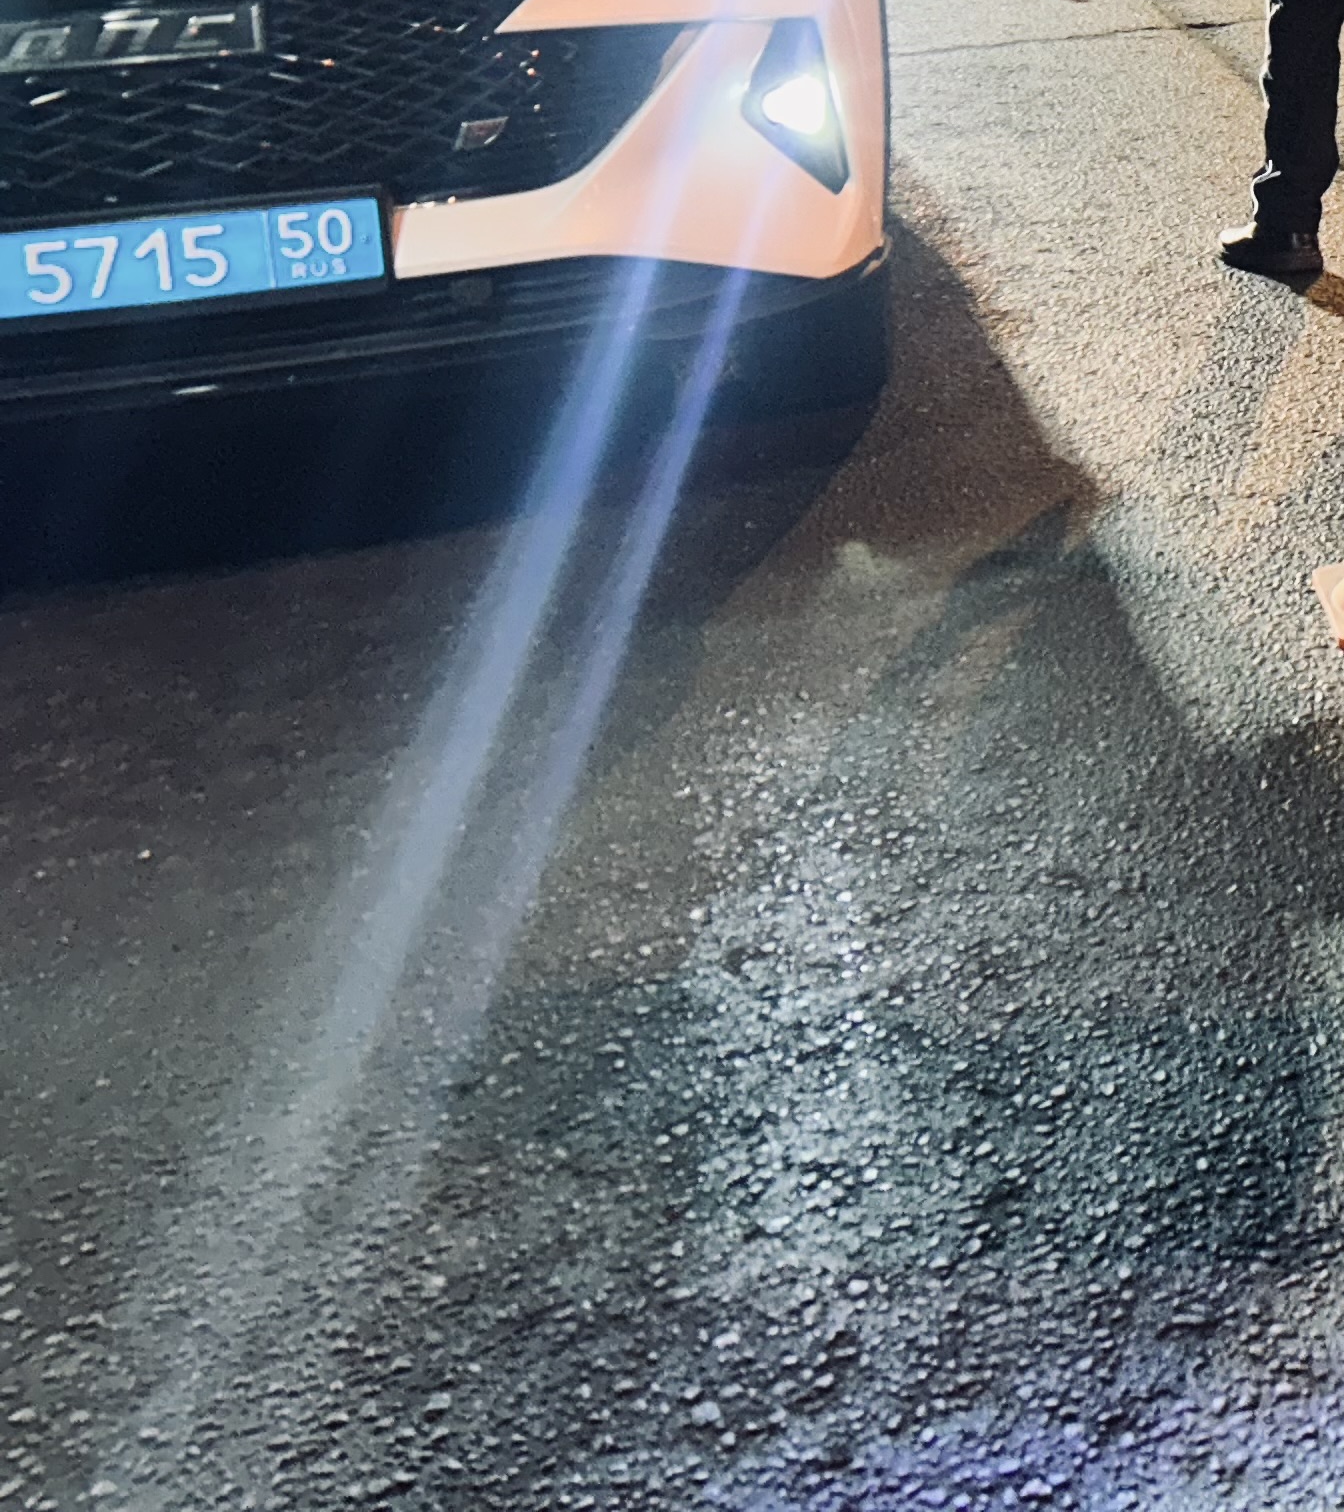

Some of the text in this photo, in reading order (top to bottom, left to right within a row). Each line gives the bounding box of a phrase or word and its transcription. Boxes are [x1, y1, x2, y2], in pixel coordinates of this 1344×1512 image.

[24, 208, 353, 305] 5715 50
[291, 257, 347, 280] RUS
